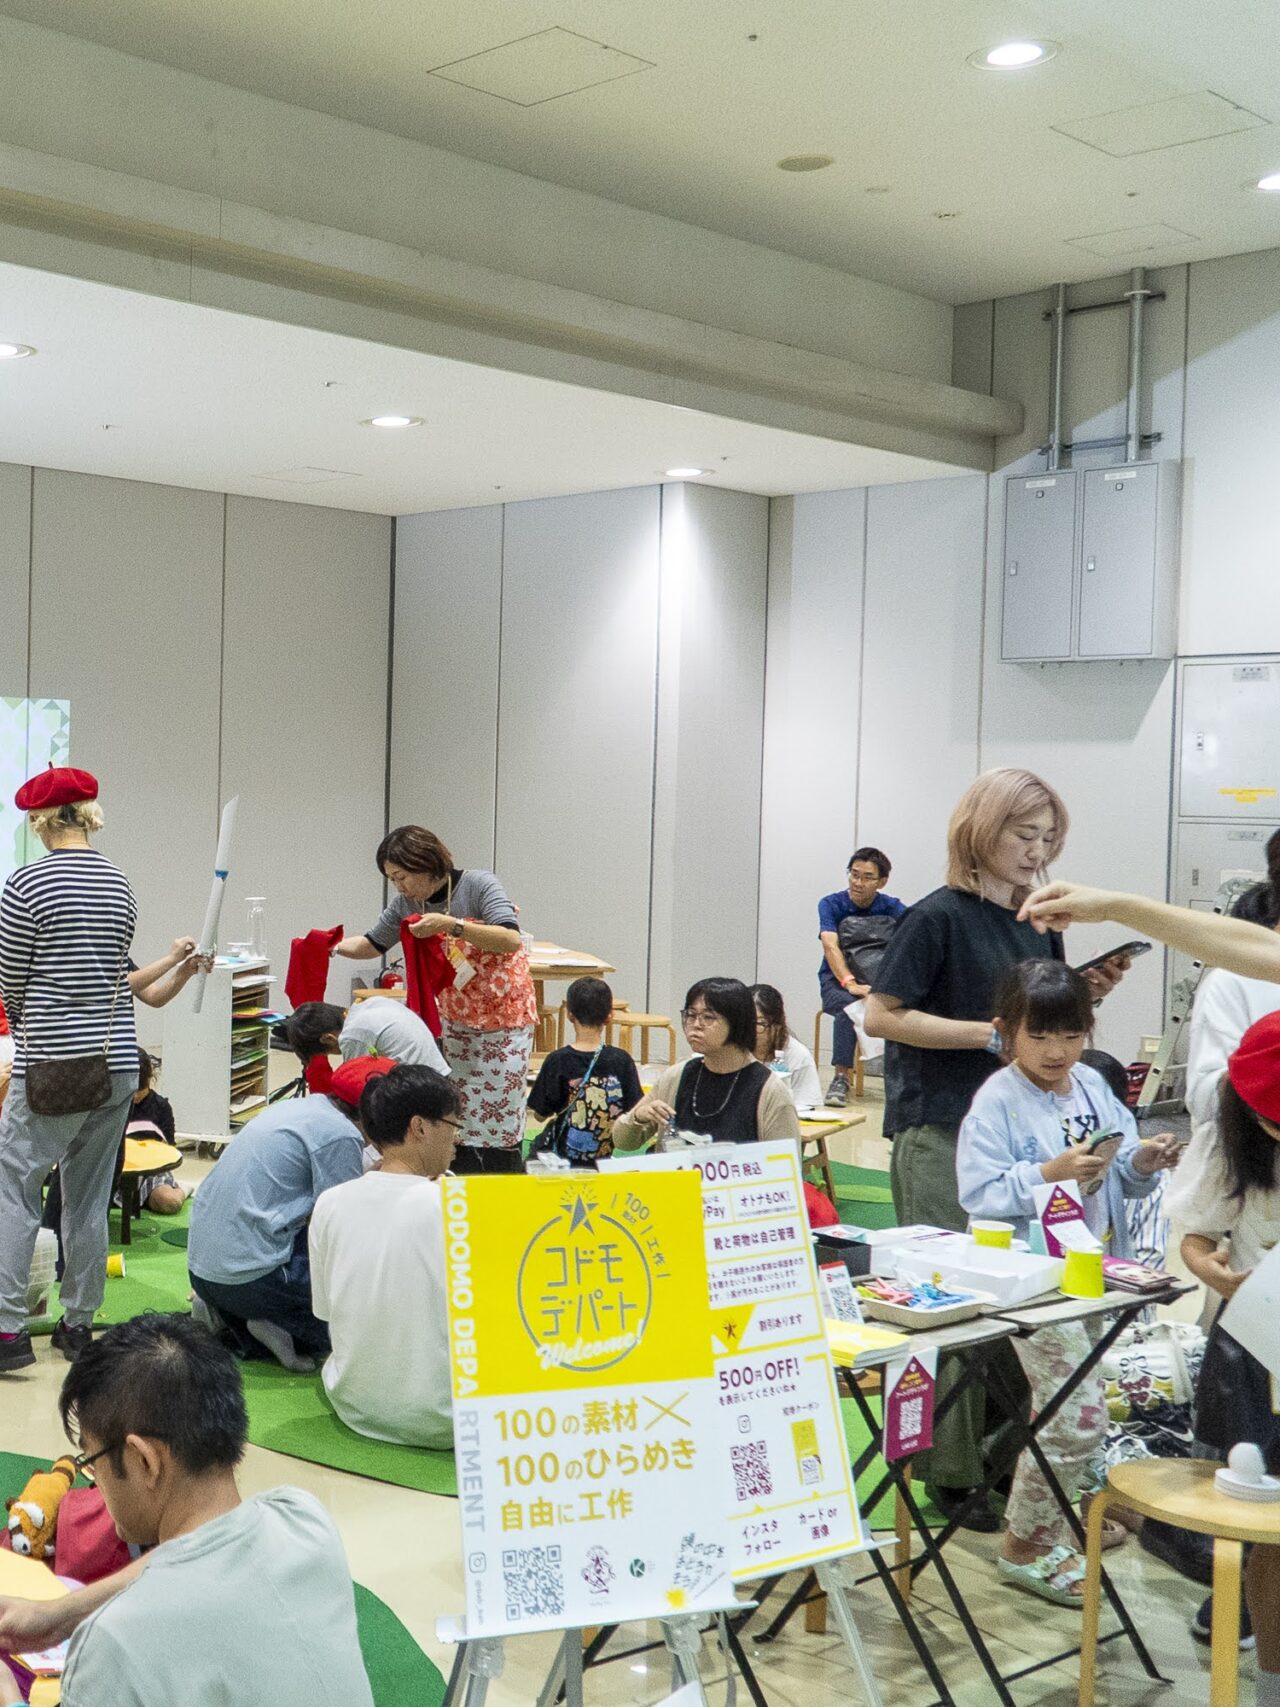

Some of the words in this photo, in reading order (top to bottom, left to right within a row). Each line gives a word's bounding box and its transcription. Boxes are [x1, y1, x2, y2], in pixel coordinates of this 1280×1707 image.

[625, 1192, 651, 1220] 100
[446, 1178, 474, 1310] KODOMO
[646, 1238, 667, 1267] 工作
[714, 1226, 797, 1251] 靴と荷物は自己管理
[545, 1244, 624, 1287] コドモ
[540, 1289, 638, 1336] デパート
[536, 1318, 645, 1370] Welcome!
[497, 1438, 697, 1488] 100のひらめき
[501, 1488, 634, 1532] 自由に工作
[742, 1519, 778, 1539] インスタ
[744, 1540, 781, 1556] フォロー
